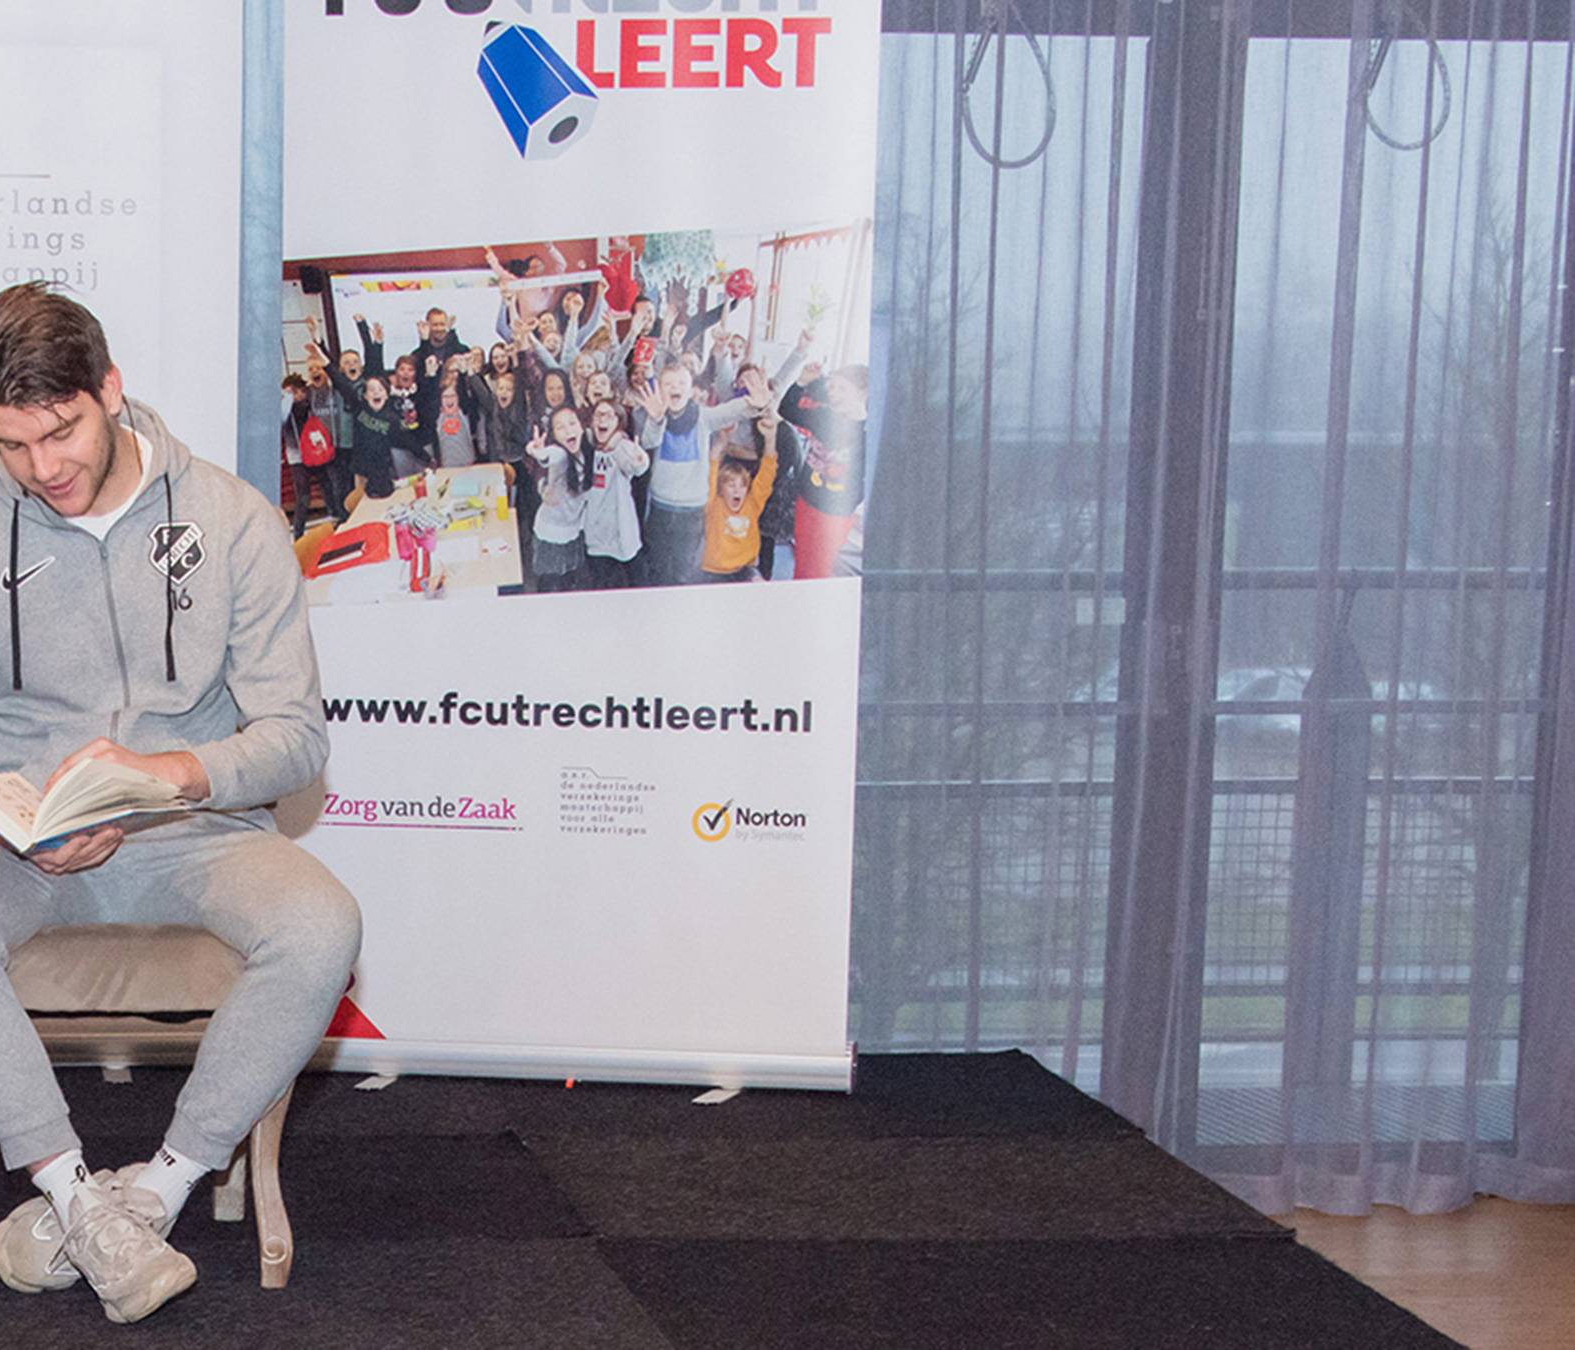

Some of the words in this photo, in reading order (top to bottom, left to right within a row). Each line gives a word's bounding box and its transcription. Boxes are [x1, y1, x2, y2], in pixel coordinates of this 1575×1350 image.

[576, 17, 832, 89] LEERT
[322, 691, 813, 733] www.fcutrechtleert.nl
[580, 782, 657, 792] nederlandse
[325, 793, 377, 822] Zorg
[381, 800, 424, 817] van
[428, 796, 456, 818] de
[458, 797, 517, 820] Zaak
[560, 793, 640, 804] verzekerings
[736, 807, 806, 827] Norton
[560, 825, 647, 836] verzekeringen
